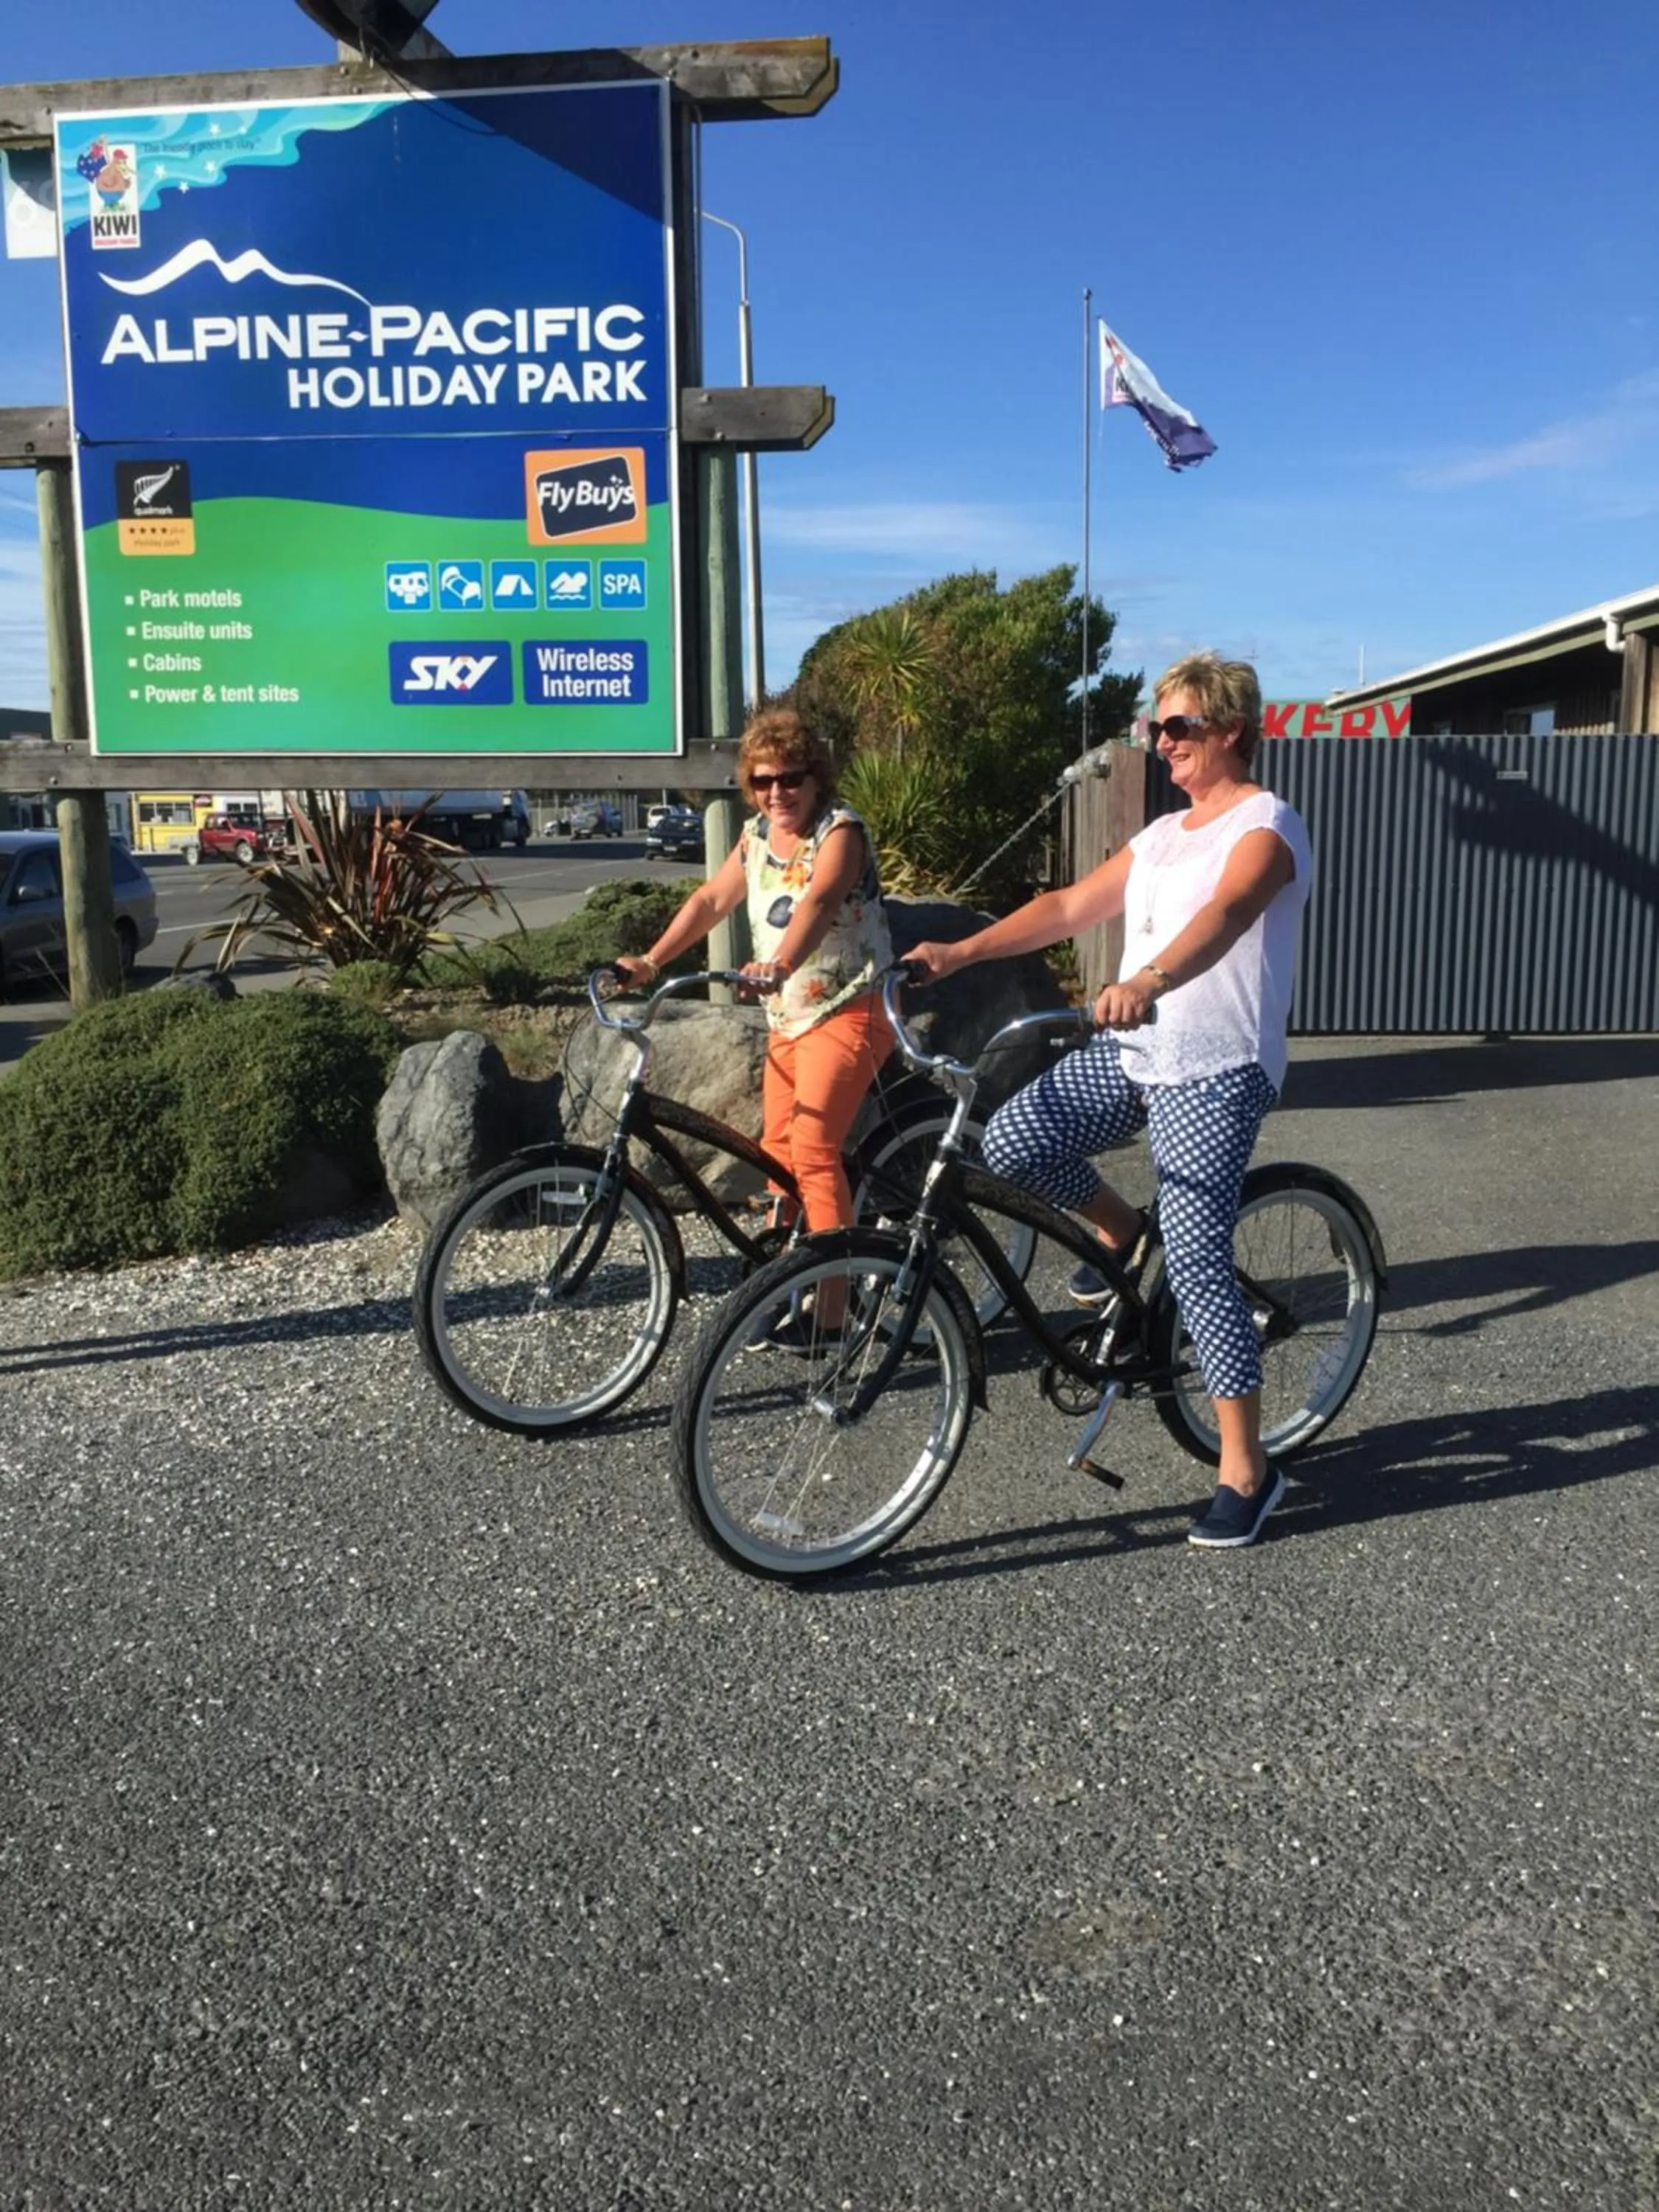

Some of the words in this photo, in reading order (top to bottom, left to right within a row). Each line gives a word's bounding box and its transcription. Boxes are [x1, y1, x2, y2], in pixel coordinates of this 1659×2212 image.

[94, 215, 137, 236] KIWI
[288, 362, 509, 408] HOLIDAY
[518, 360, 648, 403] PARK
[603, 574, 642, 595] SPA
[140, 589, 180, 608] Park
[184, 589, 243, 608] motels
[142, 622, 205, 639] Ensuite
[209, 621, 253, 639] units
[143, 653, 201, 672] Cabins
[537, 648, 635, 672] Wireless
[403, 655, 498, 692] SKY
[145, 685, 198, 703] Power
[202, 684, 215, 703] &
[220, 684, 254, 702] tent
[258, 684, 299, 702] sites
[542, 675, 632, 698] Internet
